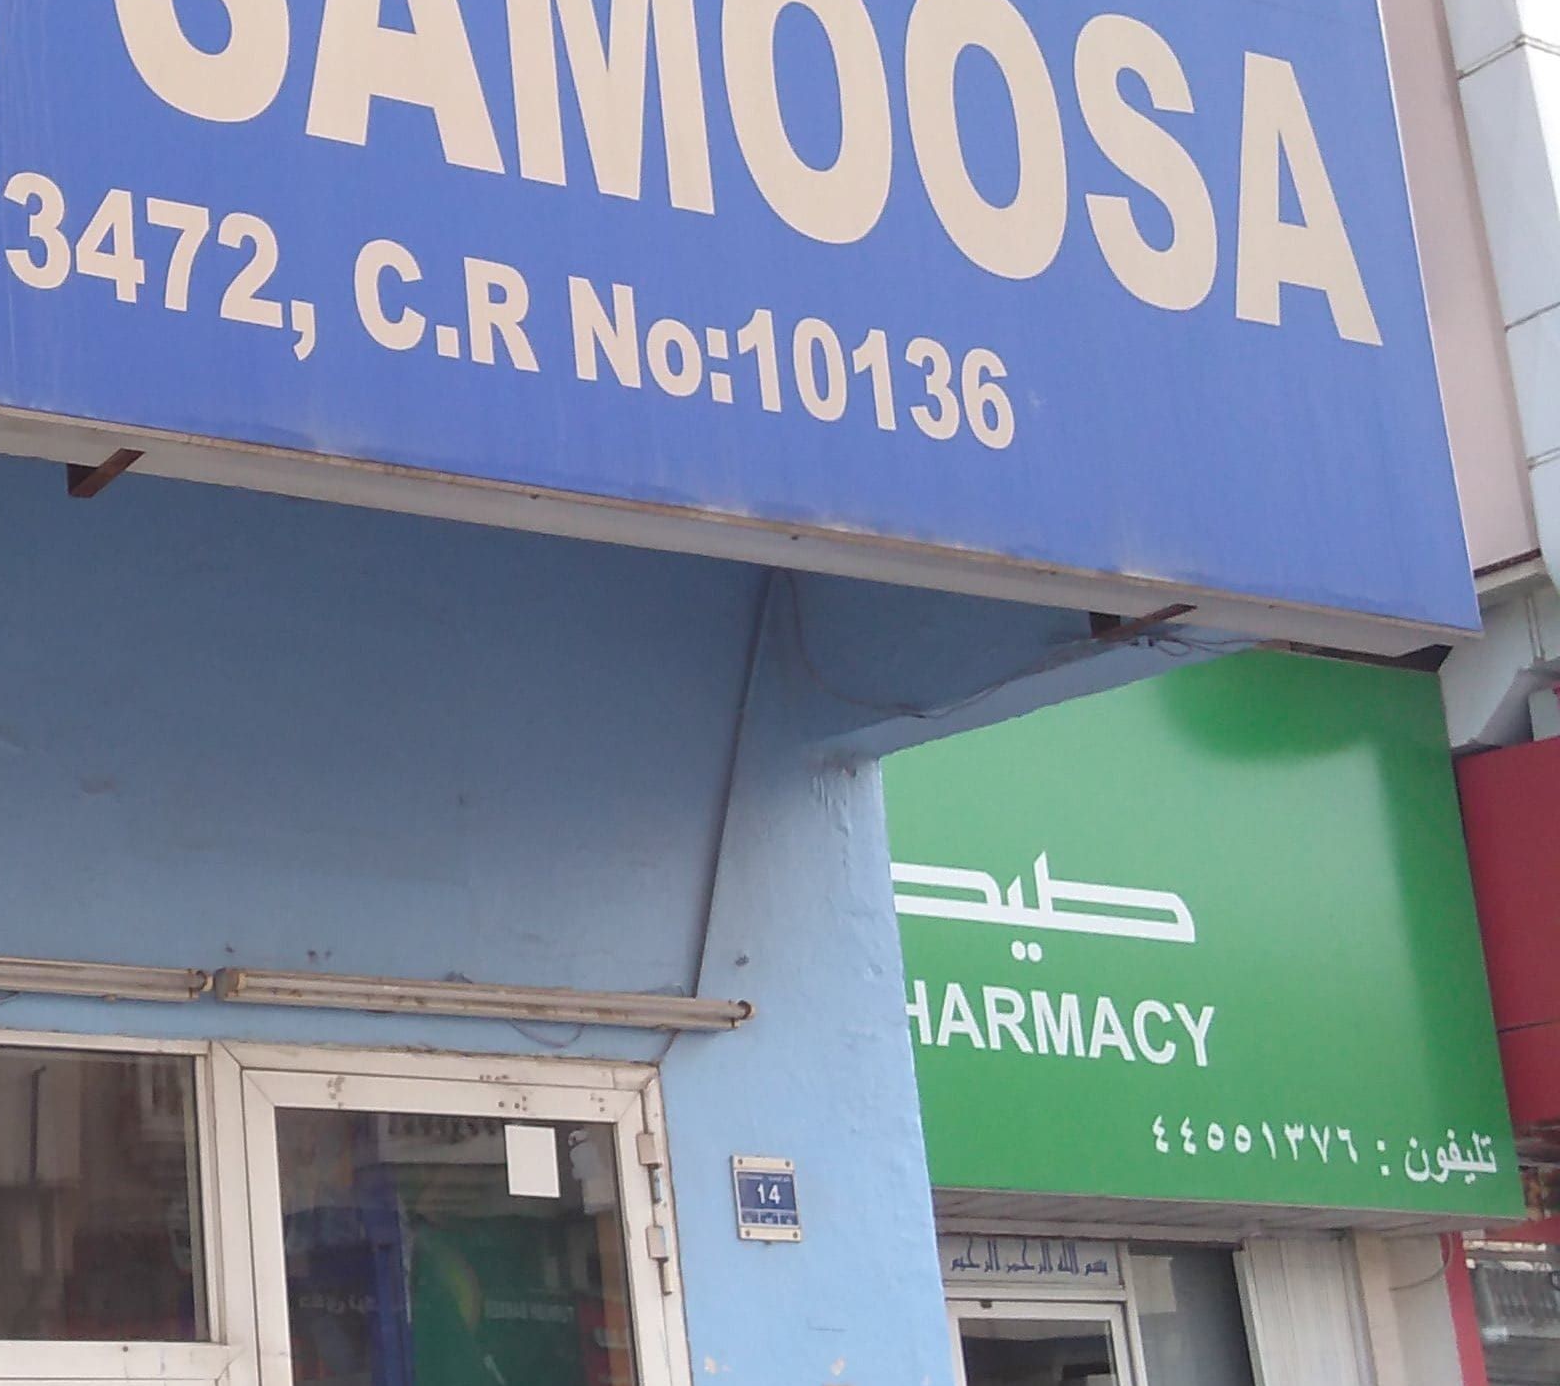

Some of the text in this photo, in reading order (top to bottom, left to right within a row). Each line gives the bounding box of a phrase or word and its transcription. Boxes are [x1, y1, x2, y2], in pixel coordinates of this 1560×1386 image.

[354, 240, 538, 371] C.R
[905, 979, 1215, 1067] HARMACY
[757, 1182, 781, 1205] 14
